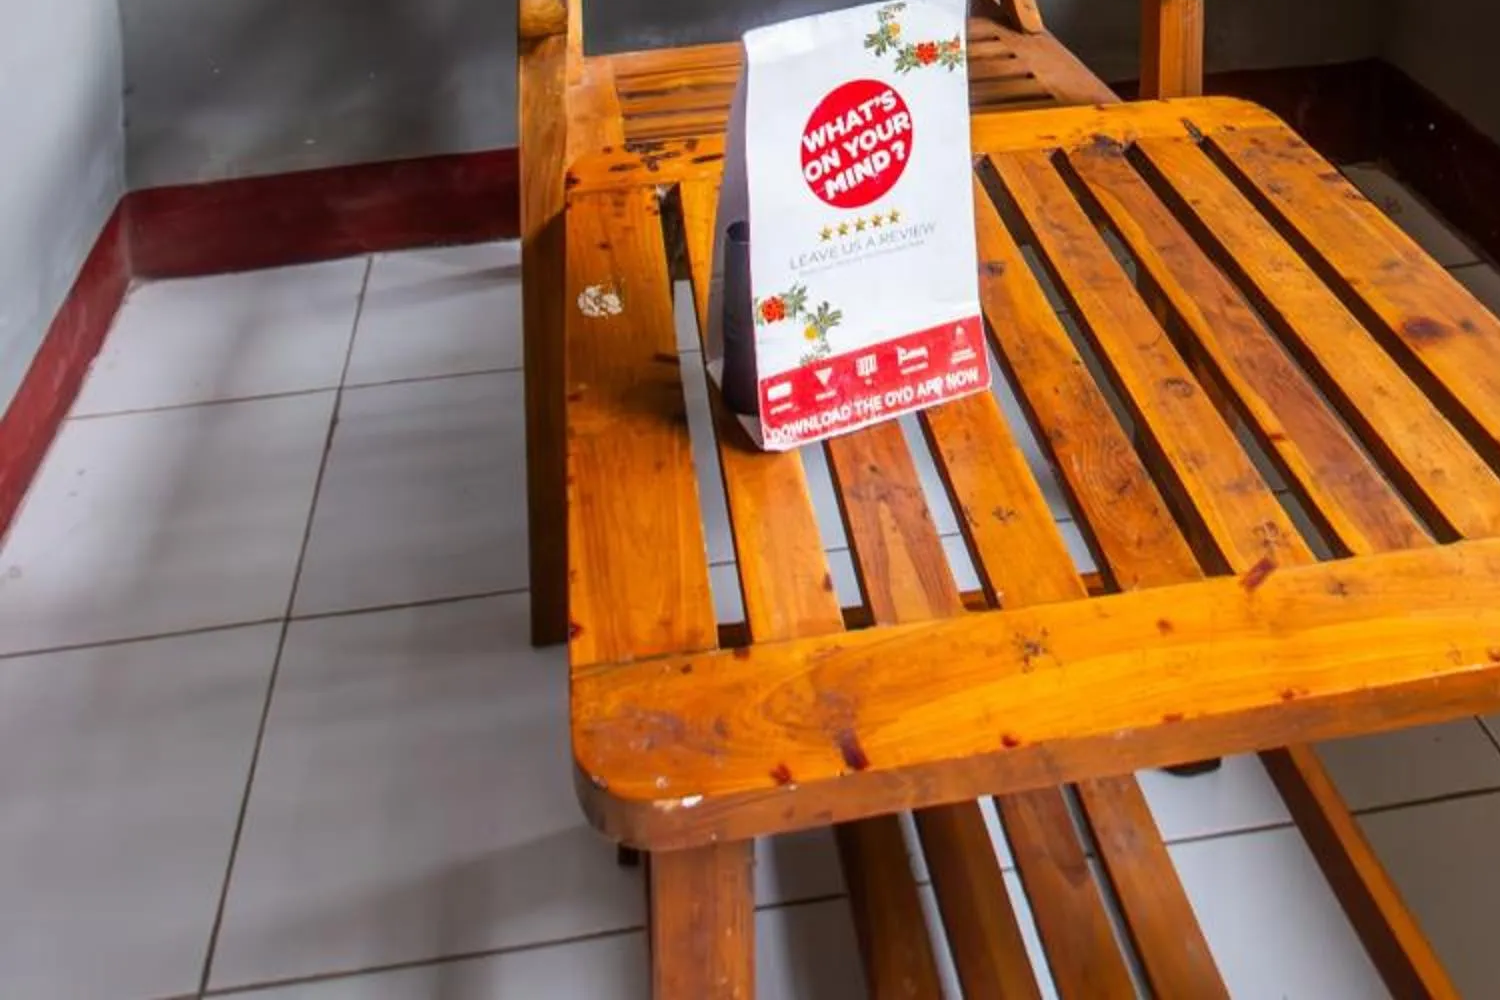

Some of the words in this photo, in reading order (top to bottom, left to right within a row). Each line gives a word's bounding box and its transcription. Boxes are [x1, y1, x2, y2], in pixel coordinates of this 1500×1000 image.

[802, 90, 898, 153] WHAT'S
[804, 148, 842, 182] ON
[842, 111, 912, 158] YOUR
[789, 245, 838, 270] LEAVE
[841, 241, 862, 255] US
[865, 235, 877, 249] A
[879, 221, 936, 245] REVIEW
[770, 404, 851, 442] DOWNLOAD
[853, 394, 884, 417] THE
[884, 385, 914, 409] OYO
[945, 367, 979, 391] NOW
